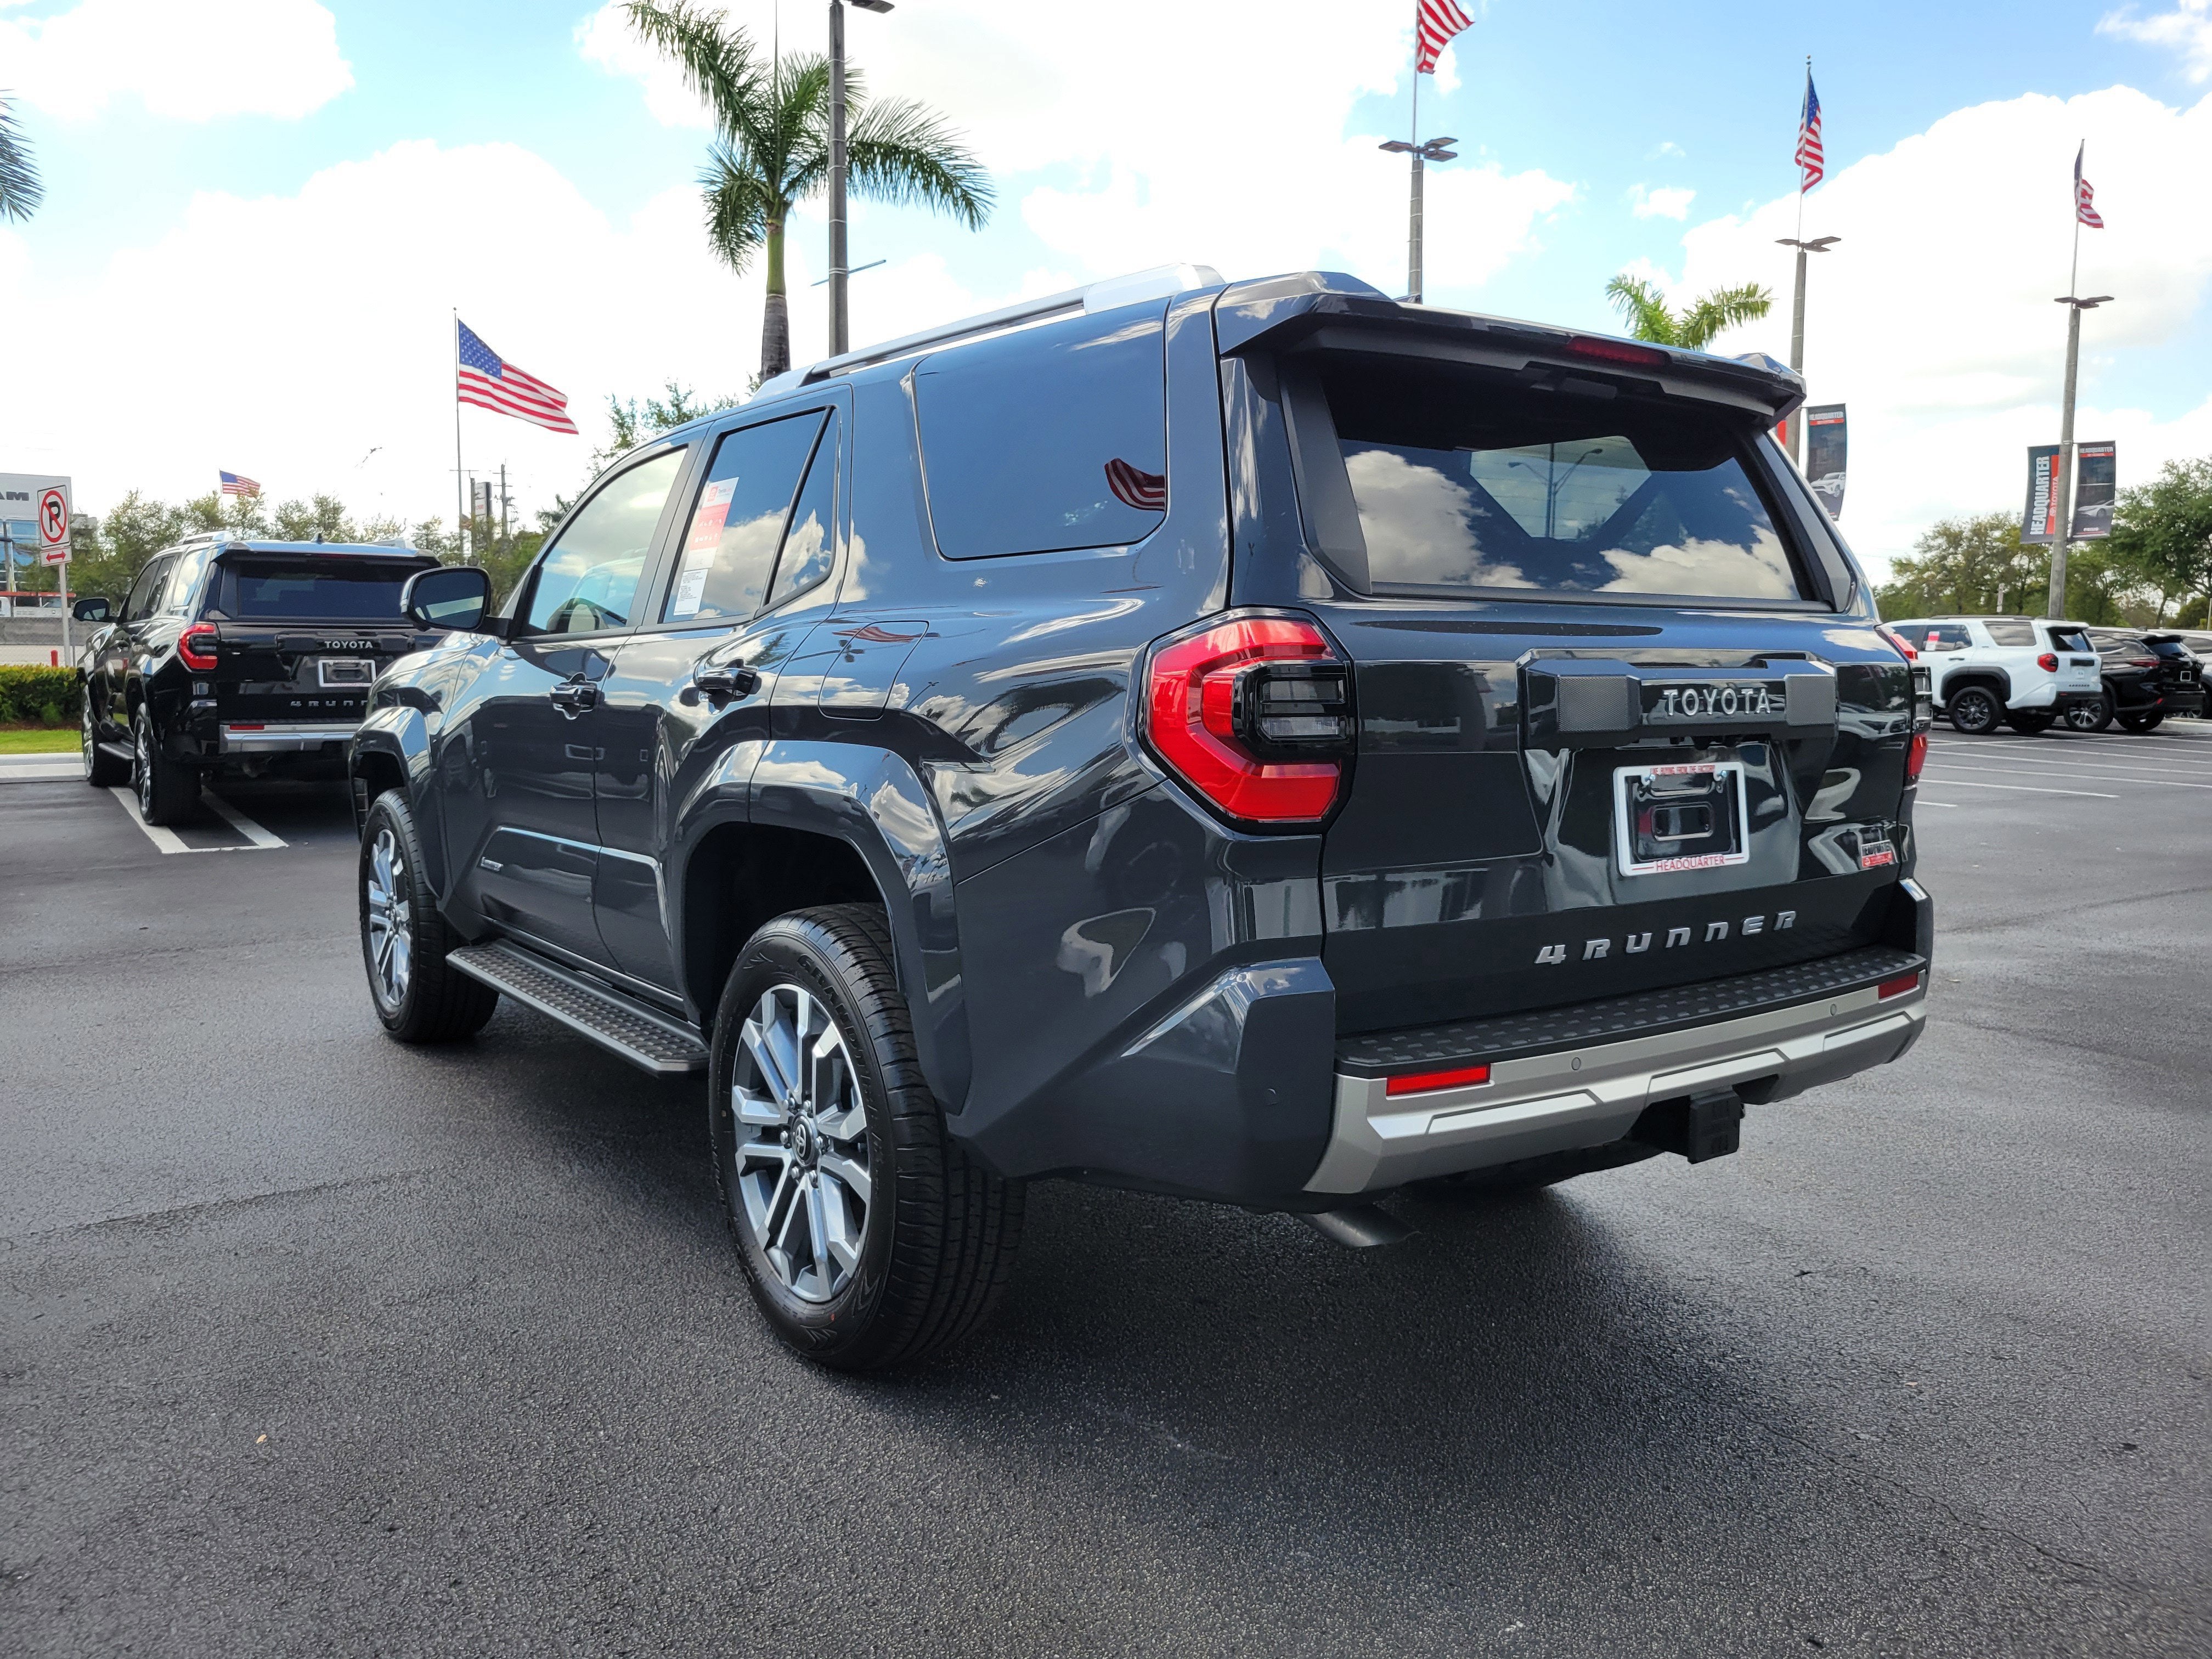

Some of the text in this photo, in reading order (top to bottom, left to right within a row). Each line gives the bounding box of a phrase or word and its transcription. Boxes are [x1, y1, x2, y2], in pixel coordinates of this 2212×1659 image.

[2030, 456, 2050, 535] HEADQUARTER
[324, 641, 374, 649] TOYOTA
[1663, 688, 1771, 716] TOYOTA
[1656, 855, 1725, 872] HEADQUARTER
[1534, 910, 1797, 965] 4RUNNER
